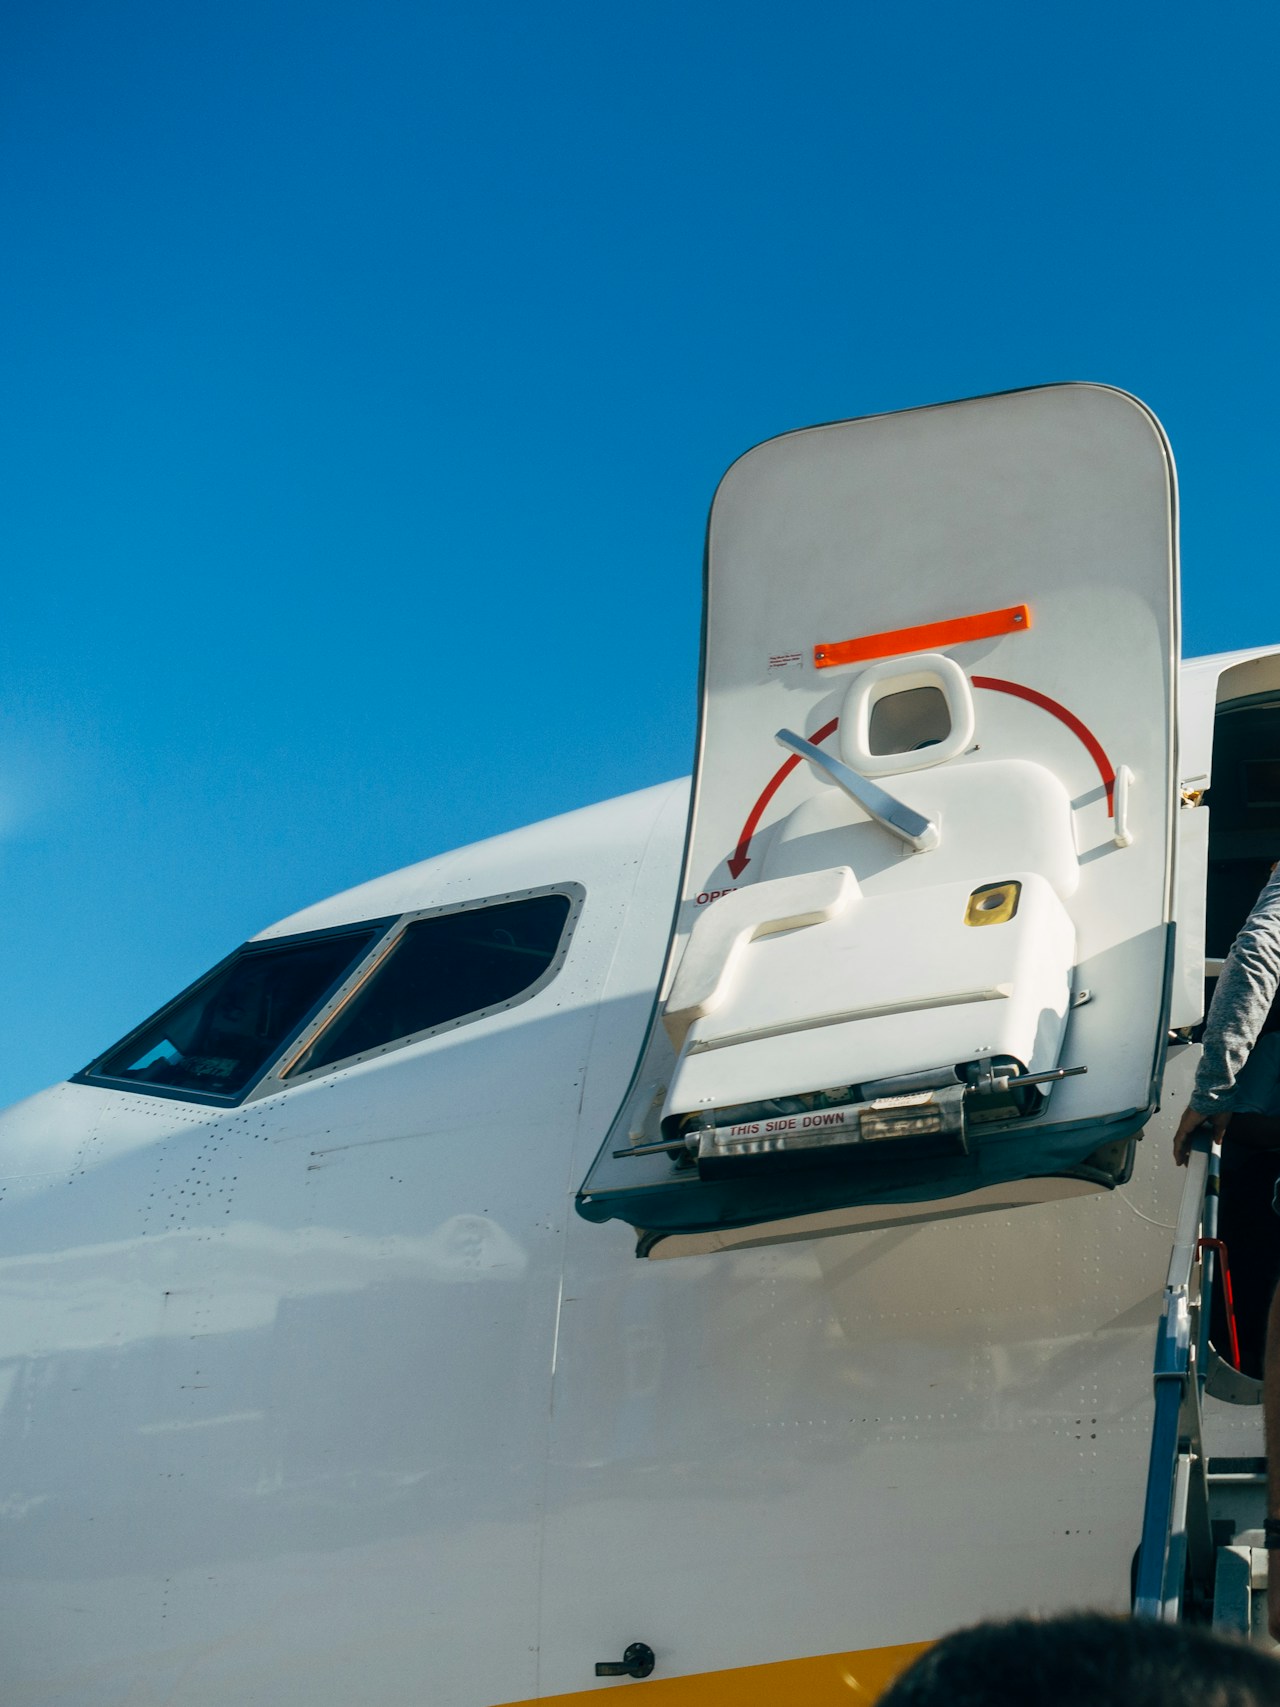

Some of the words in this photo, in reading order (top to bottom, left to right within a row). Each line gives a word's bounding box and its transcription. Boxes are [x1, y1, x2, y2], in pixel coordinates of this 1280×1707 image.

[696, 887, 738, 905] OPE
[730, 1123, 760, 1136] THIS
[765, 1118, 797, 1132] SIDE
[802, 1112, 845, 1127] DOWN
